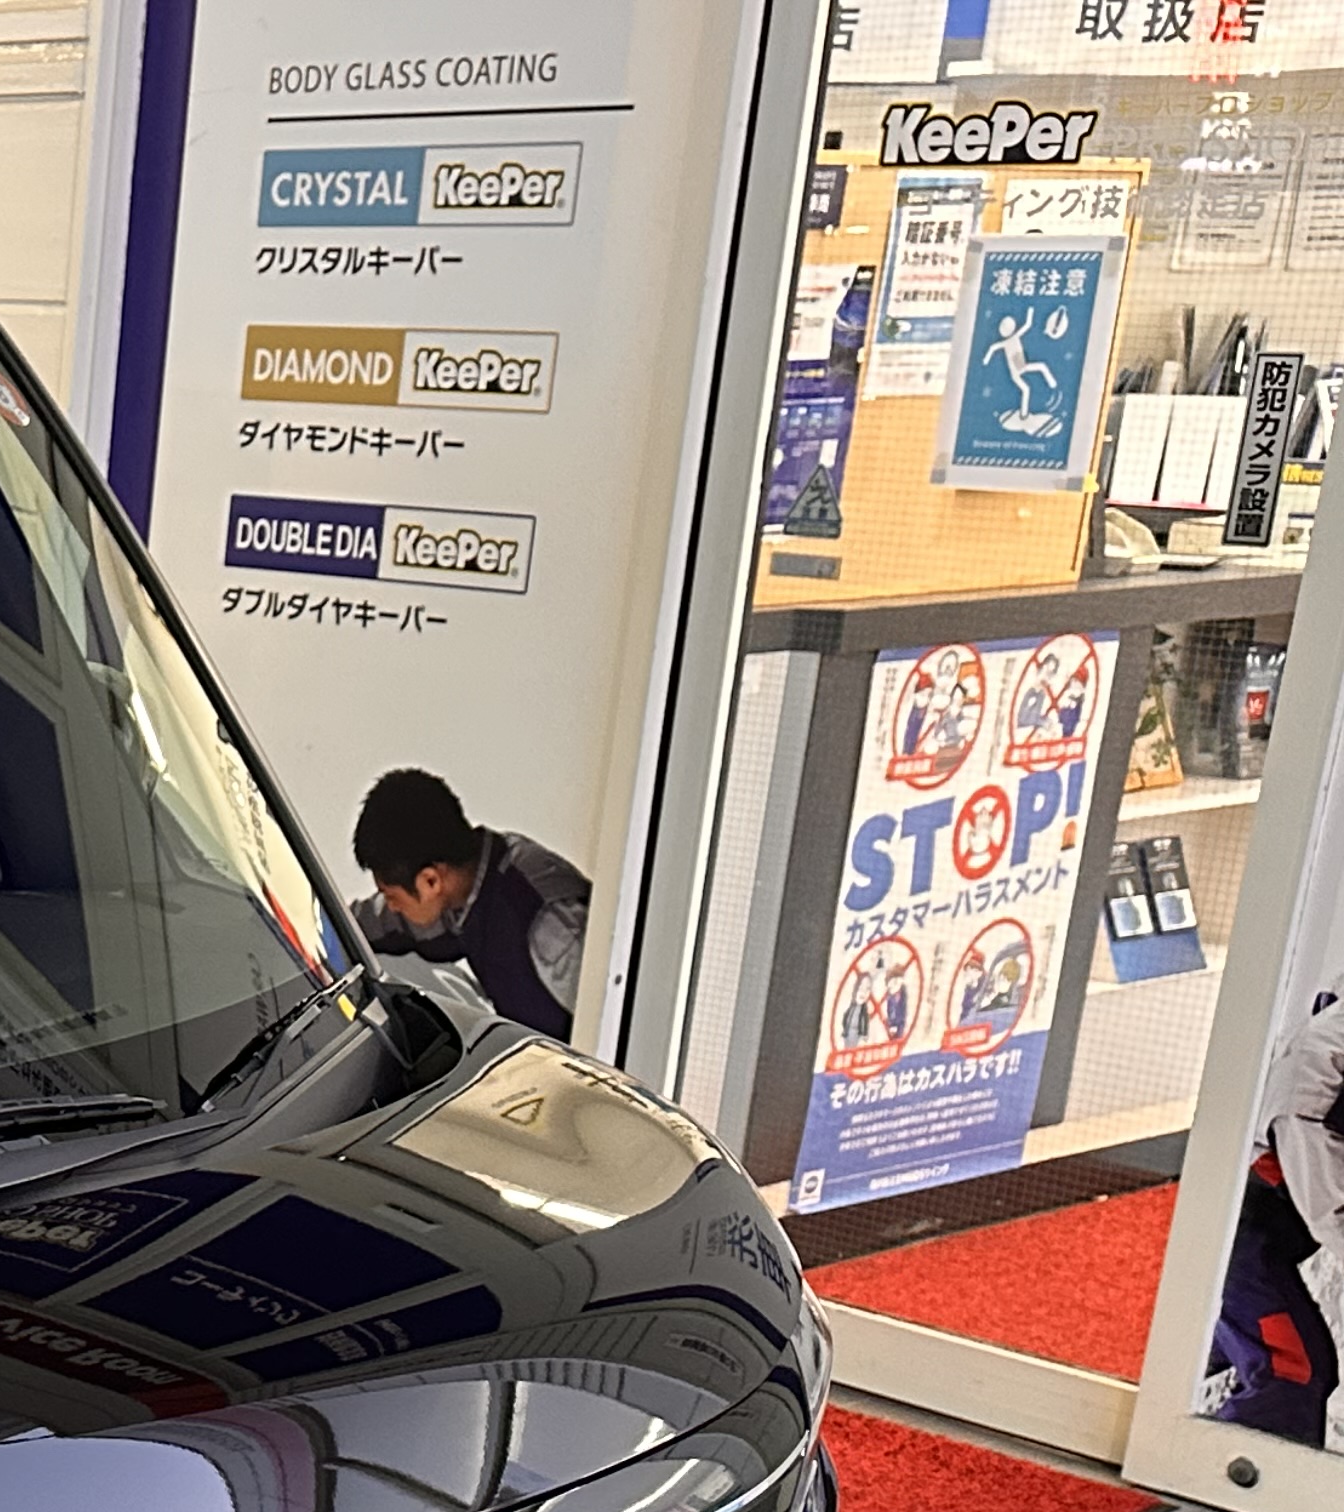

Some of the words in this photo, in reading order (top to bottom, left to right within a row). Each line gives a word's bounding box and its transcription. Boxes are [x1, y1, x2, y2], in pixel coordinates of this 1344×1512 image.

[1075, 0, 1265, 43] 取扱店
[269, 63, 338, 94] BODY
[345, 59, 427, 91] GLASS
[436, 52, 558, 87] COATING
[880, 100, 1099, 166] KeePer
[271, 170, 408, 207] CRYSTAL
[434, 162, 564, 209] KeePer
[256, 245, 463, 276] クリスタルキーパー
[990, 268, 1088, 298] 凍結注意
[253, 348, 394, 386] DIAMOND
[413, 347, 541, 394] KeePer
[239, 420, 465, 458] ダイヤモンドキーパー
[1234, 361, 1293, 537] 防犯カメラ設置
[235, 517, 332, 556] DOUBLE
[336, 526, 377, 560] DIA
[393, 524, 518, 576] KeePer
[223, 587, 448, 632] ダブルダイヤキーパー
[844, 859, 1069, 950] カスタマーハラスメント
